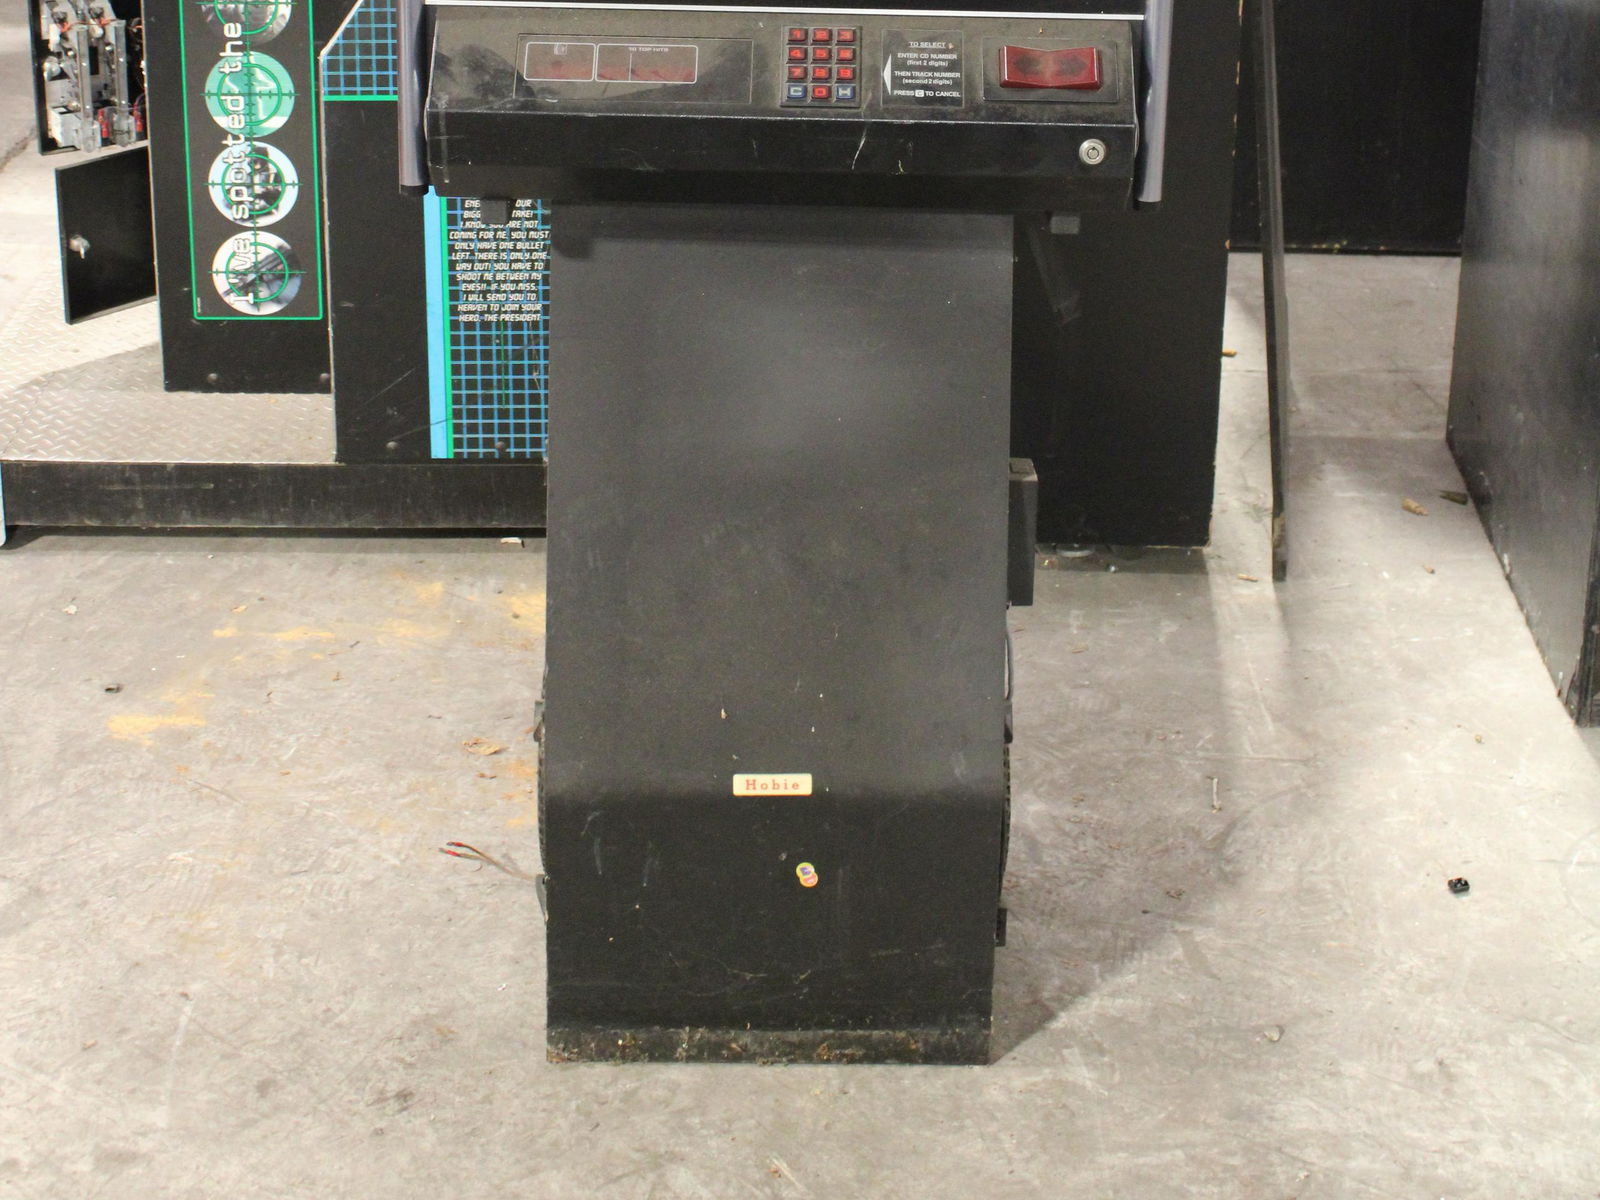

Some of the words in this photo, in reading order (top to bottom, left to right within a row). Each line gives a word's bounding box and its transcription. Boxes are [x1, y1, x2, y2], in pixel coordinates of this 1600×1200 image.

[219, 21, 244, 74] the
[928, 60, 949, 68] digits)
[902, 78, 928, 86] (second
[221, 95, 255, 221] spotted
[515, 199, 532, 208] OUR
[463, 209, 481, 218] BIGG
[479, 231, 494, 239] FOR
[511, 231, 527, 239] YOU
[454, 241, 475, 249] ONLY
[476, 241, 497, 249] HAVE
[499, 241, 515, 249] ONE
[516, 241, 545, 250] BULLET
[474, 252, 498, 260] THERE
[510, 252, 530, 260] ONLY
[531, 252, 547, 260] ONE
[455, 262, 472, 270] WAY
[494, 262, 510, 270] YOU
[511, 262, 532, 270] HAVE
[228, 238, 254, 305] I've
[456, 272, 481, 281] SHOOT
[495, 273, 530, 281] BETWEEN
[500, 283, 517, 291] YOU
[486, 293, 507, 301] SEND
[508, 293, 525, 301] YOU
[457, 303, 488, 311] HEAVEN
[501, 303, 520, 311] JOIN
[521, 303, 543, 311] YOUR
[484, 313, 499, 321] THE
[500, 313, 542, 322] PRESIDENT
[745, 779, 800, 791] Hobie
